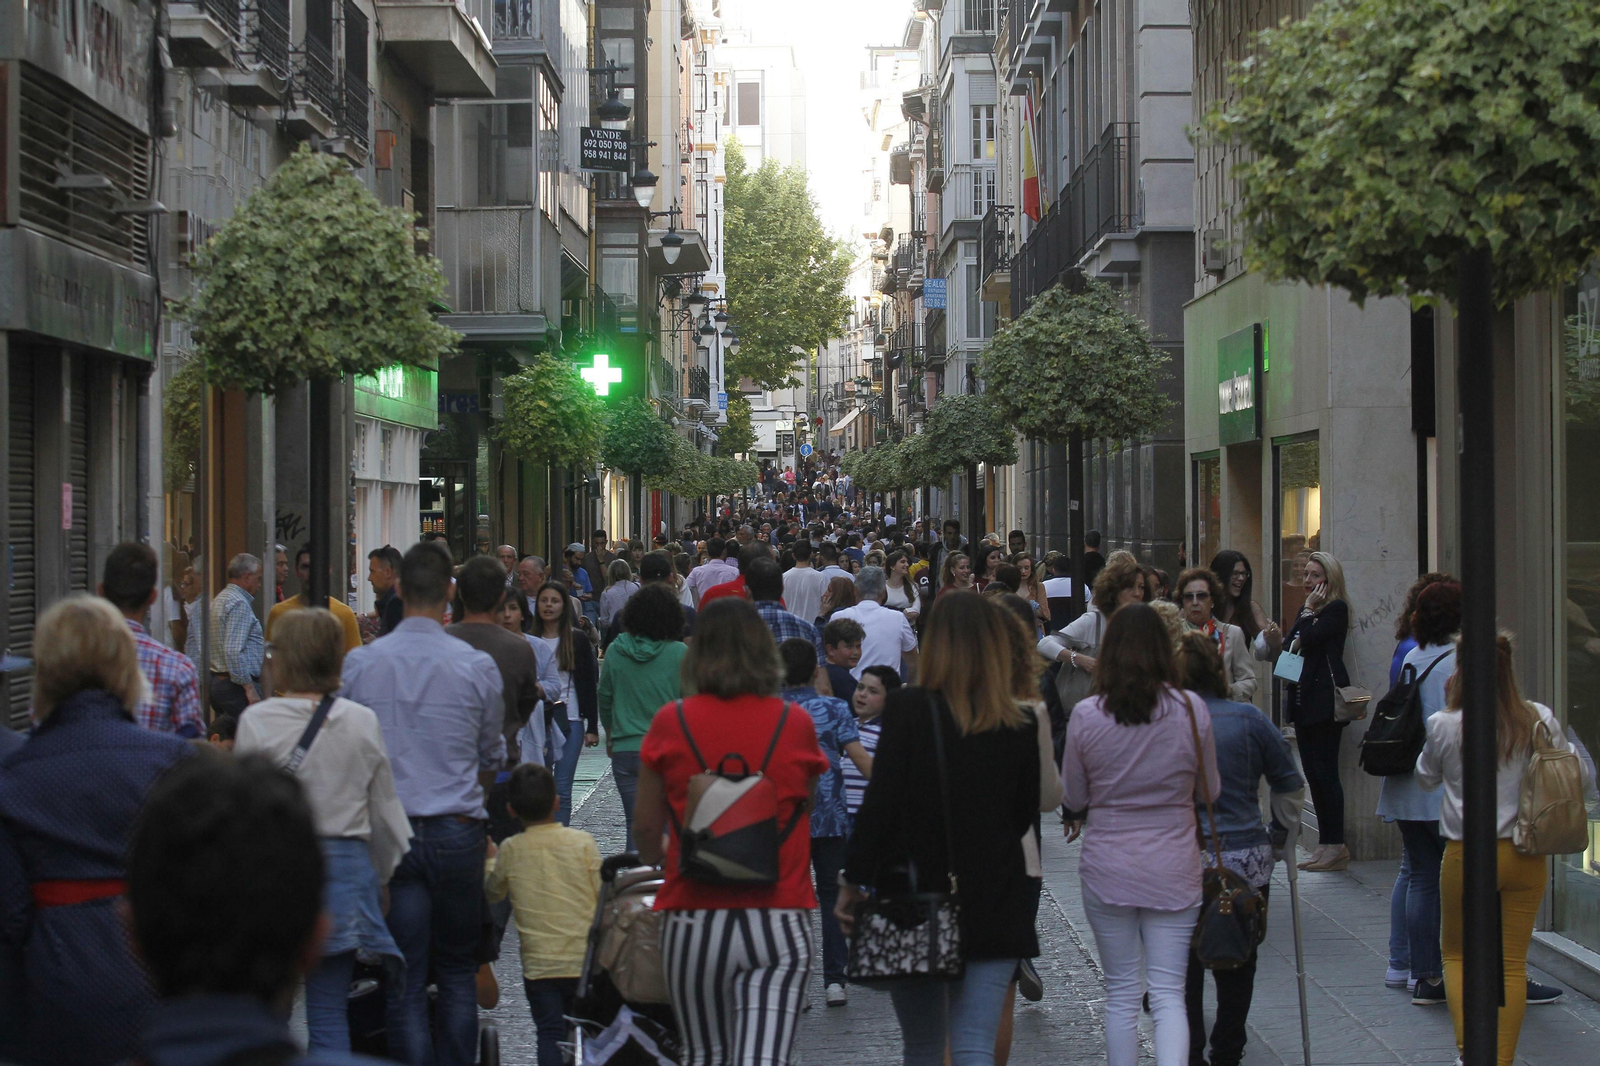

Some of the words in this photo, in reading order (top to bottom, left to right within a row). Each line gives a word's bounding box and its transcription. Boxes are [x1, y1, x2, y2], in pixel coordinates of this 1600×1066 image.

[590, 129, 622, 140] VENDE
[583, 139, 597, 148] 692
[598, 140, 612, 149] 050
[613, 141, 627, 150] 908
[583, 150, 597, 158] 958
[598, 151, 611, 160] 941
[613, 152, 627, 161] 844
[924, 279, 932, 288] SE
[924, 298, 933, 307] 652
